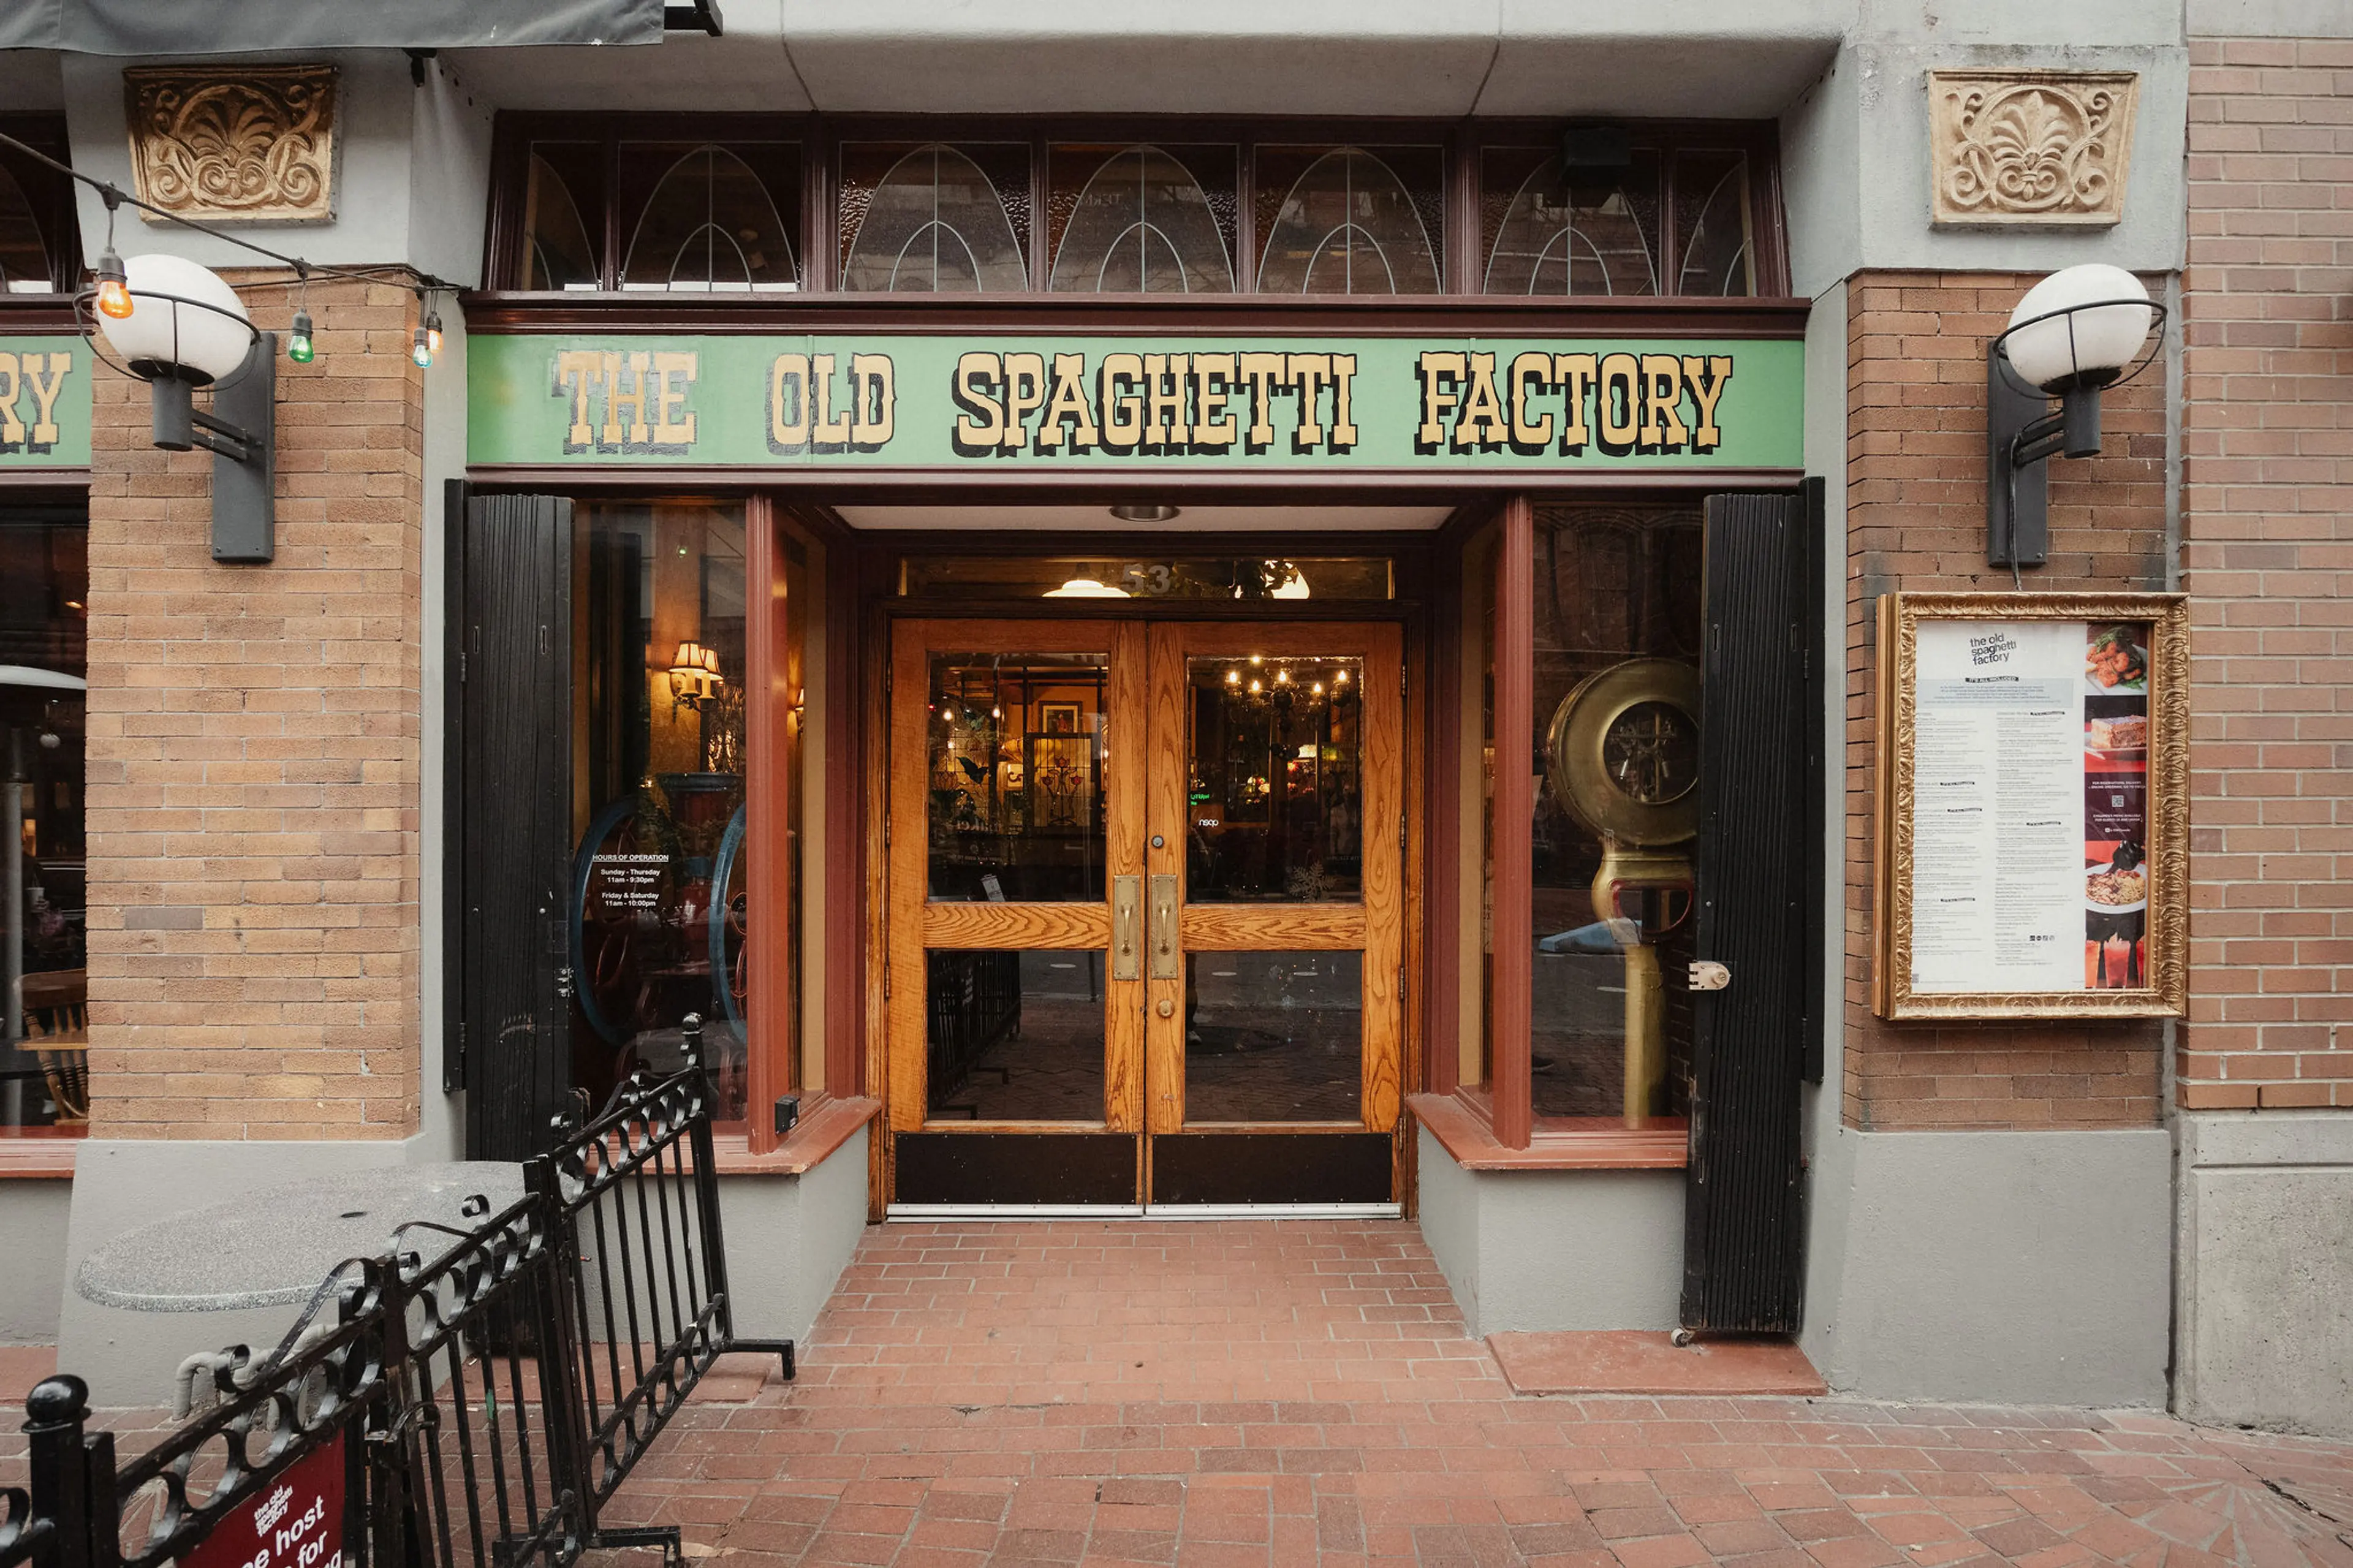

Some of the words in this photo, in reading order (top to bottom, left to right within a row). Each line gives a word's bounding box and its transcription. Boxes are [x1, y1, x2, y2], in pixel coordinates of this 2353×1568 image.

[553, 350, 697, 455] THE
[767, 352, 897, 455] OLD
[952, 350, 1357, 457] SPAGHETTI
[1414, 351, 1733, 456] FACTORY
[1121, 563, 1170, 594] 53
[1970, 638, 1986, 648] the
[1989, 632, 2004, 644] old
[1971, 640, 2017, 656] spaghetti
[1973, 653, 2009, 665] factory
[276, 1495, 325, 1557] host
[297, 1531, 327, 1568] for
